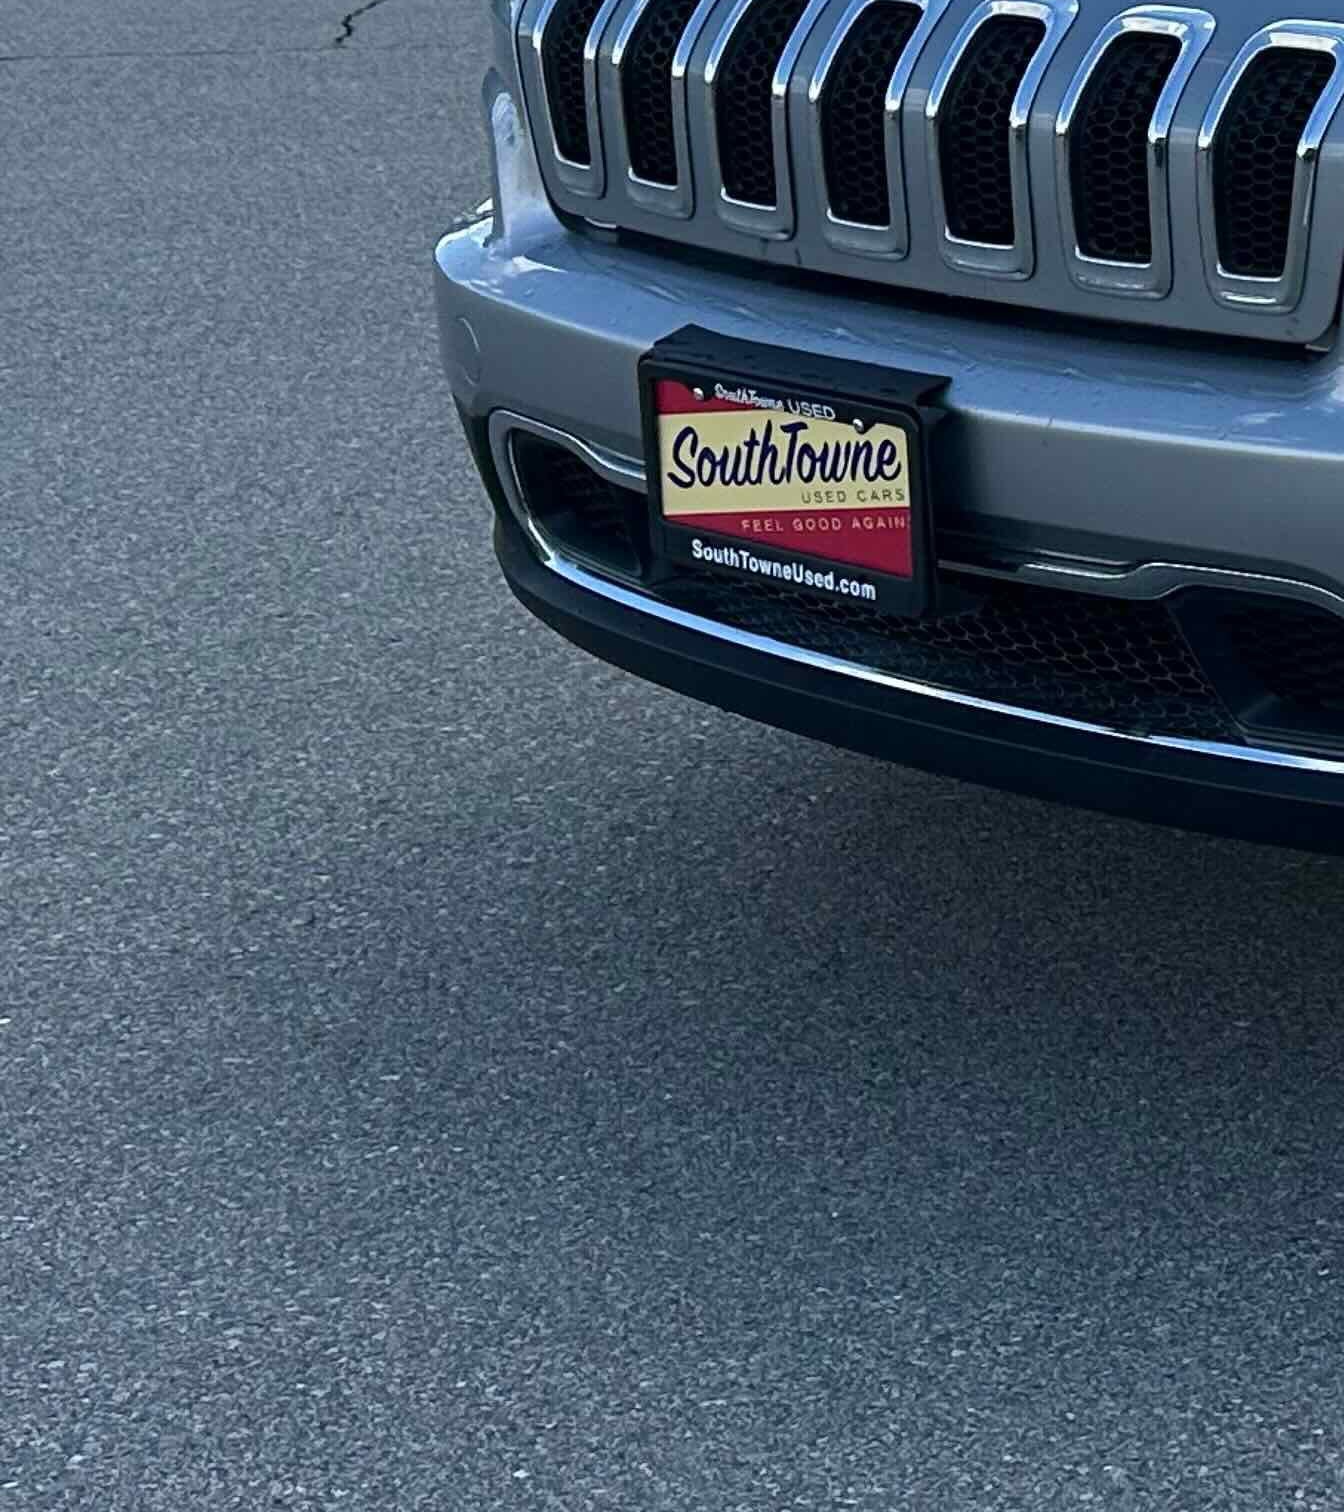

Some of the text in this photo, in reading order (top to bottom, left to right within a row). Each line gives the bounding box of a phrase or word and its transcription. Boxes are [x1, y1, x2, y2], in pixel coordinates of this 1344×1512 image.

[787, 399, 836, 421] USED
[667, 420, 901, 489] SouthTowne
[801, 488, 906, 504] USED CARS
[741, 519, 784, 532] FEEL
[792, 517, 842, 531] GOOD
[691, 538, 877, 601] SouthTowneUsed.com
